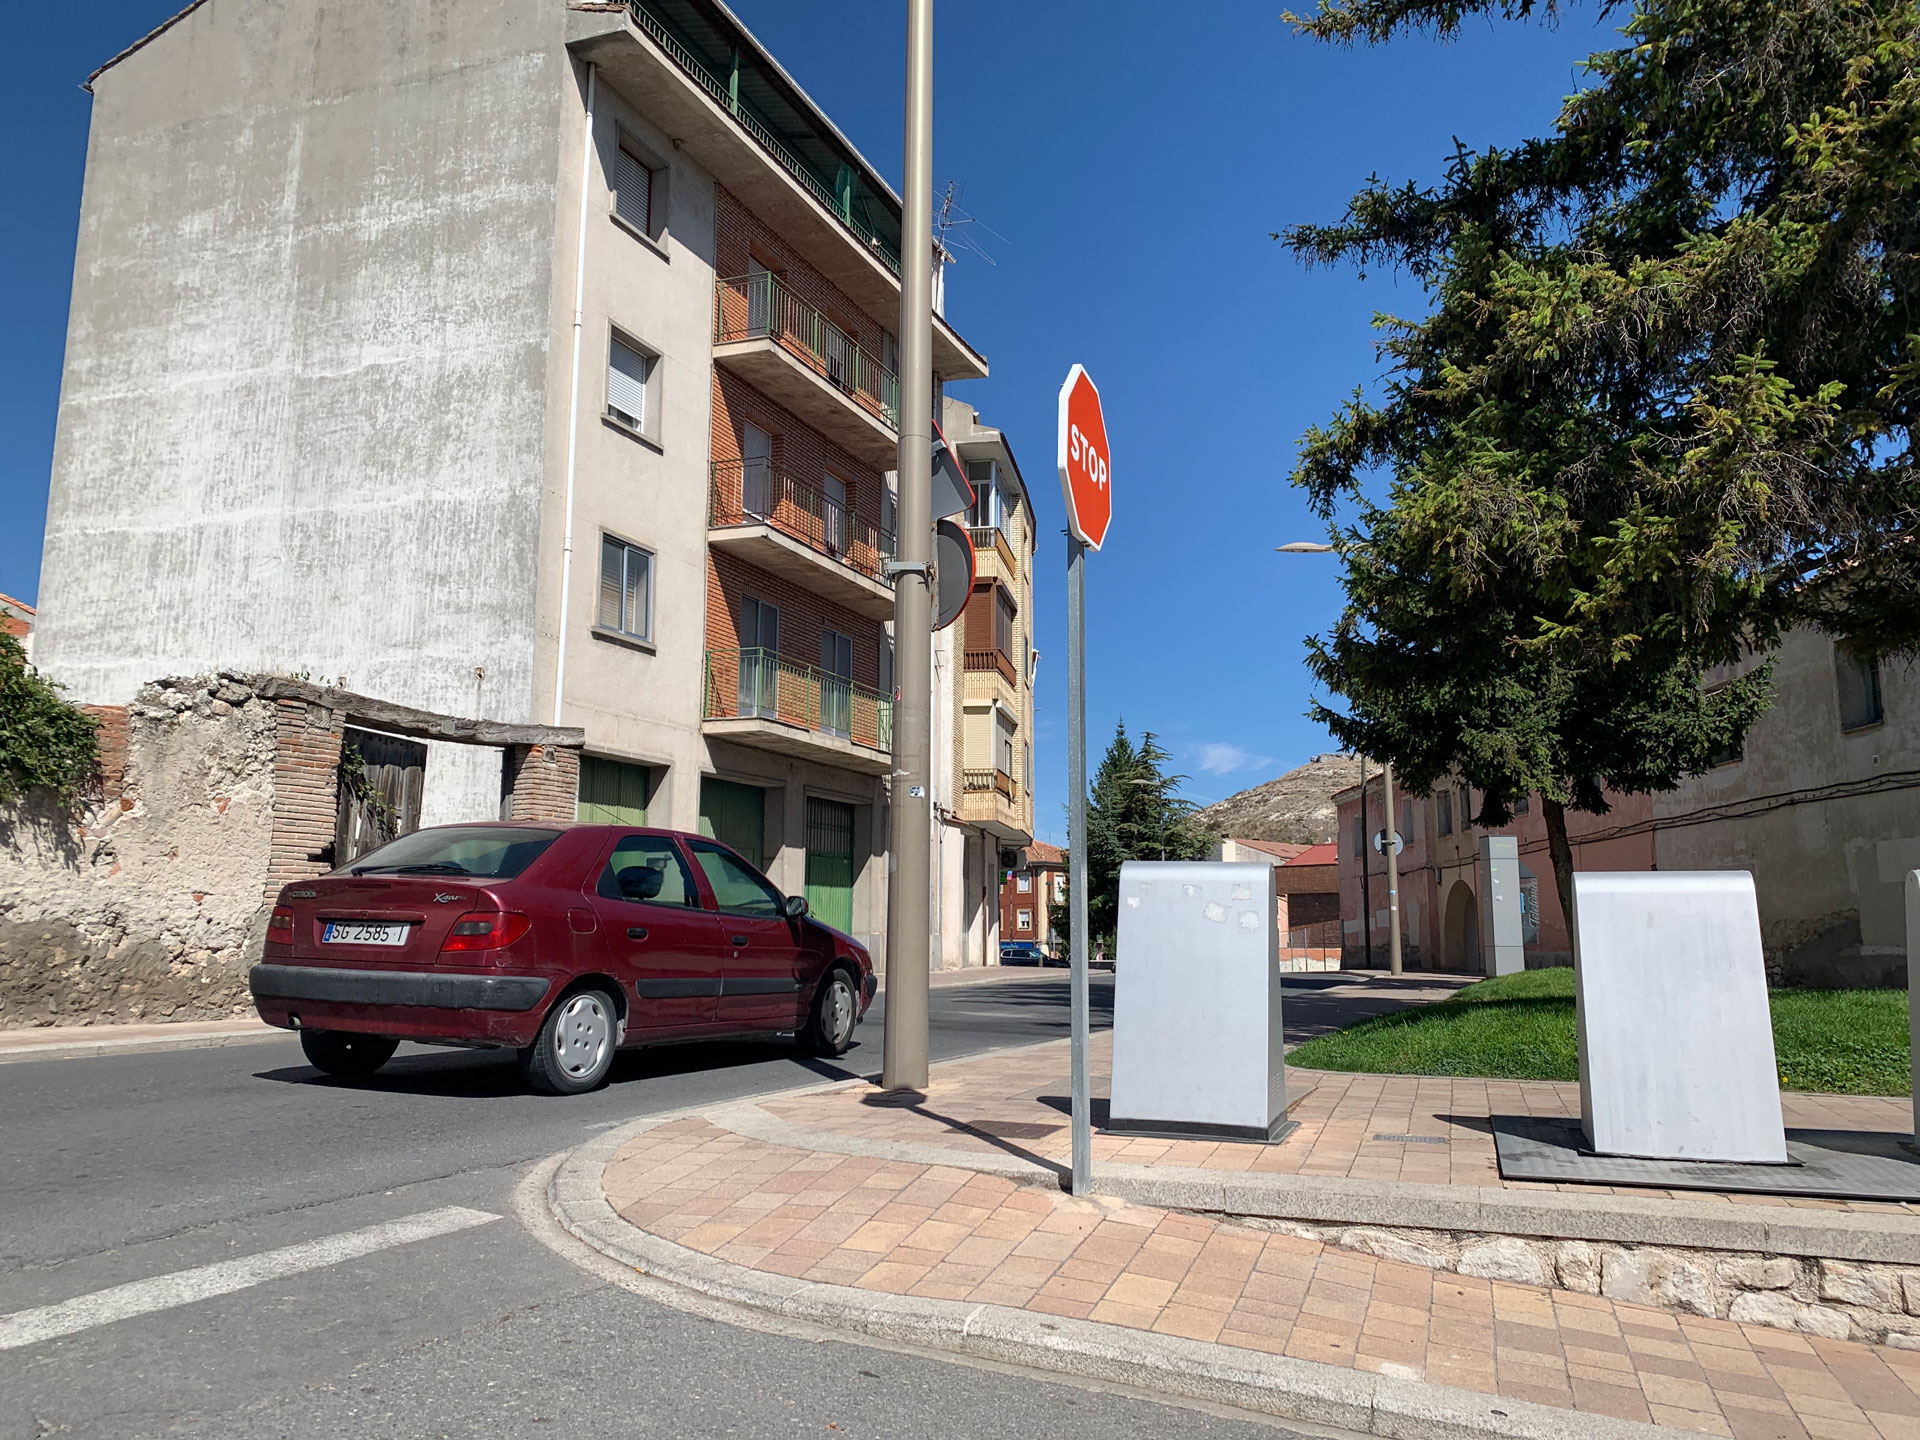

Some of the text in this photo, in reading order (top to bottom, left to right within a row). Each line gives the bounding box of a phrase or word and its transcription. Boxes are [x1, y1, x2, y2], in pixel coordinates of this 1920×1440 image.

[1071, 424, 1107, 491] STOP
[332, 923, 404, 942] SG 2585 I
